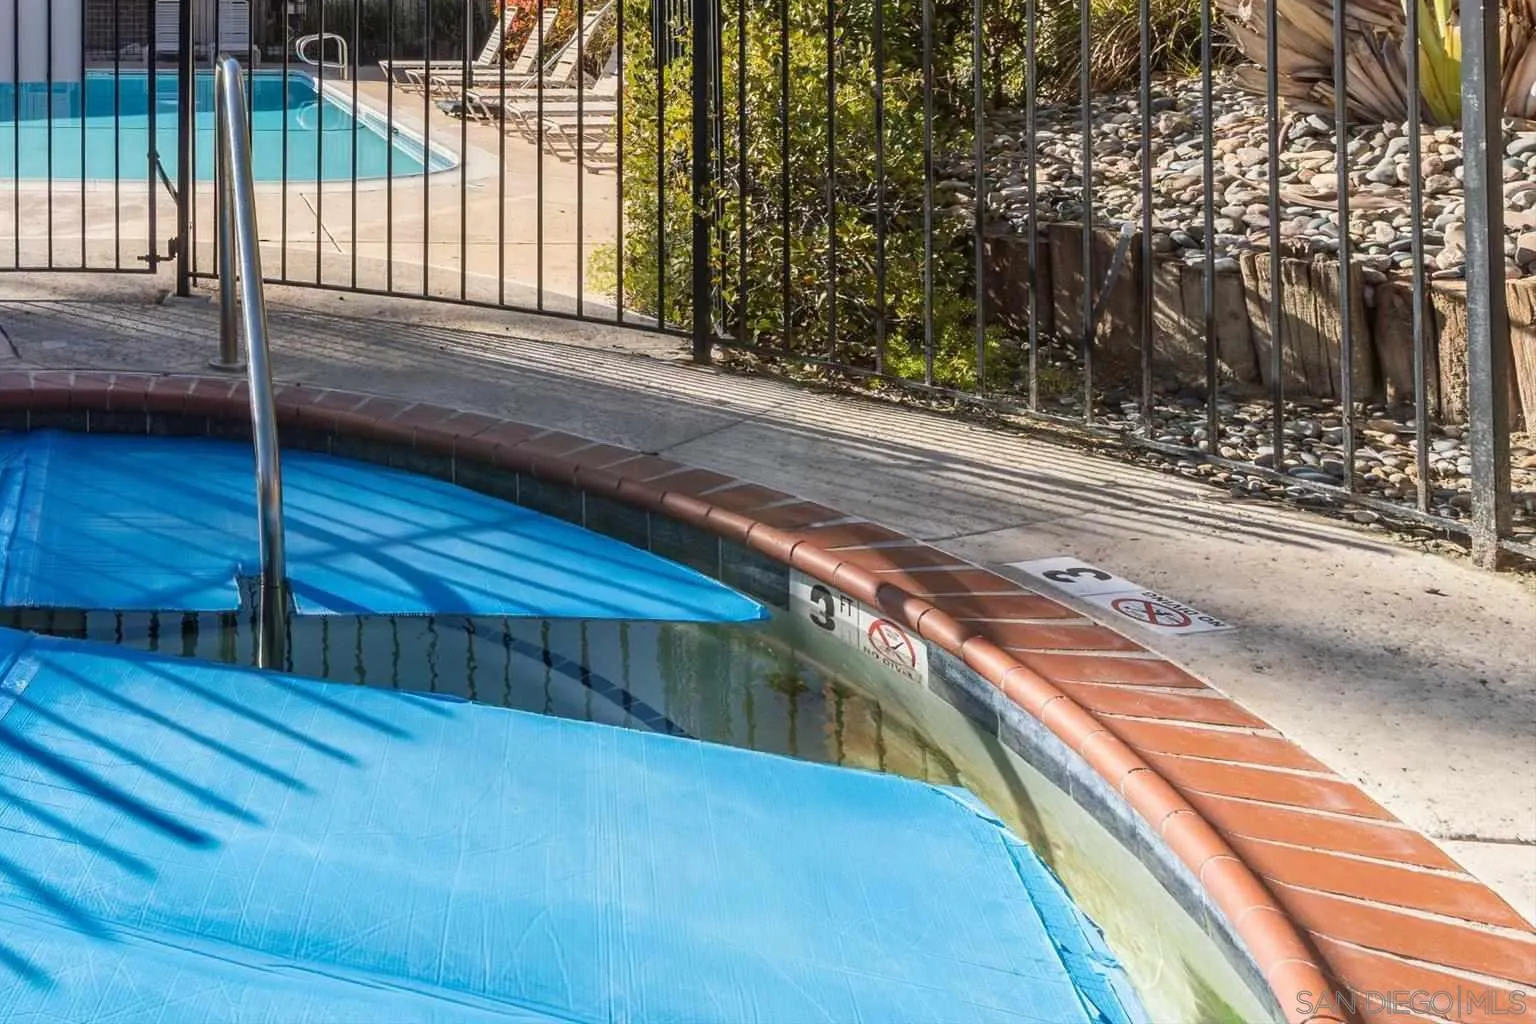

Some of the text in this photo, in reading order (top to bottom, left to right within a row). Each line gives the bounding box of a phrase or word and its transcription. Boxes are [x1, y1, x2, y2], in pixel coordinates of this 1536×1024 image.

[1042, 567, 1113, 584] 3
[810, 584, 853, 631] 3 FT
[1197, 616, 1226, 627] NO
